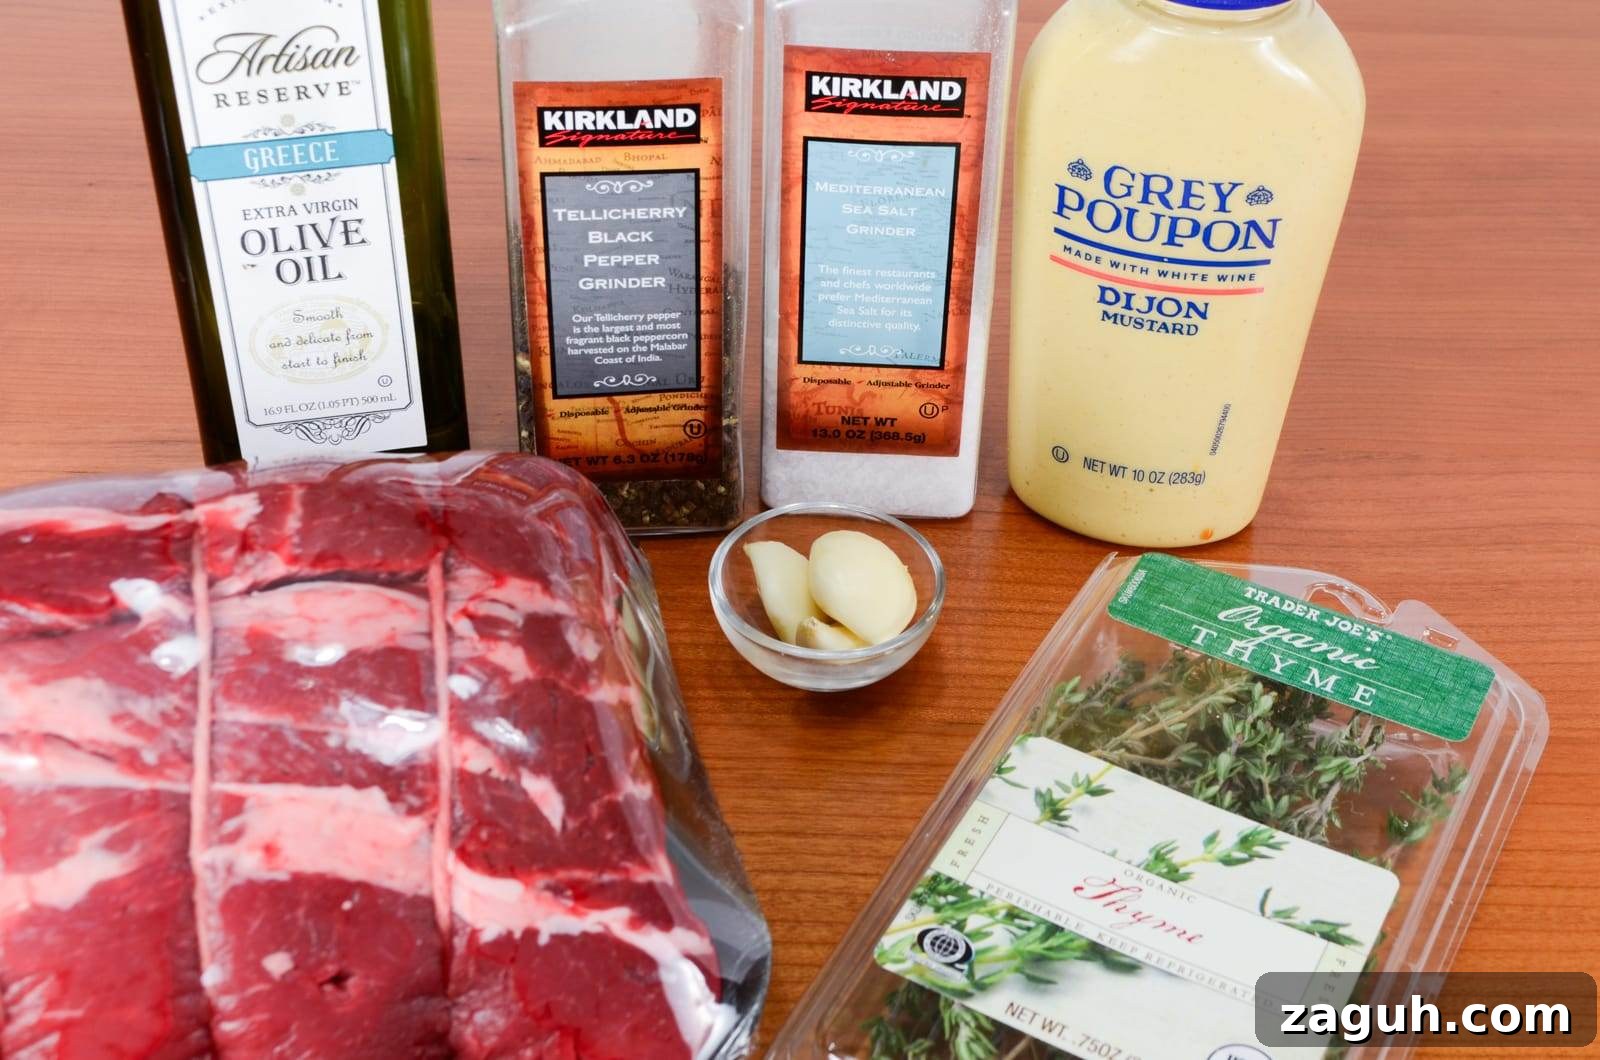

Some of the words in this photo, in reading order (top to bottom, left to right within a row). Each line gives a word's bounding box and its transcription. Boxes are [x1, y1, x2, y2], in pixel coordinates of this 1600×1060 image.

[196, 25, 360, 84] Artisan
[214, 81, 353, 109] RESERVE
[811, 75, 962, 101] KIRKLAND
[811, 96, 960, 114] Signature
[543, 108, 697, 131] KIRKLAND
[545, 129, 696, 148] Signature
[243, 140, 340, 174] GREECE
[815, 181, 945, 197] MEDITERRANEAN
[1103, 164, 1244, 213] GREY
[241, 205, 297, 221] EXTRA
[303, 198, 359, 215] VIRGIN
[552, 207, 687, 222] TELLICHERRY
[842, 203, 872, 215] SEA
[878, 204, 917, 217] SALT
[1052, 182, 1282, 253] POUPON
[240, 216, 370, 256] OLIVE
[588, 231, 653, 244] BLACK
[846, 223, 916, 237] GRINDER
[275, 254, 346, 285] OIL
[583, 254, 660, 267] PEPPER
[1063, 244, 1102, 265] MADE
[1110, 259, 1149, 276] WITH
[1157, 268, 1208, 282] WHITE
[1217, 272, 1257, 283] WINE
[818, 264, 839, 274] The
[842, 265, 872, 277] finest
[875, 267, 936, 279] restaurants
[578, 276, 666, 290] GRINDER
[820, 278, 840, 289] and
[843, 279, 872, 290] chefs
[874, 281, 932, 293] worldwide
[818, 292, 851, 304] prefer
[854, 293, 933, 305] Mediterranean
[1097, 284, 1209, 320] DIJON
[293, 307, 343, 324] Smooth
[572, 314, 592, 323] Our
[594, 312, 644, 323] Tellicherry
[647, 310, 682, 322] pepper
[837, 306, 855, 316] Sea
[858, 306, 877, 316] Salt
[880, 307, 896, 317] for
[899, 308, 912, 318] its
[573, 326, 581, 334] is
[586, 324, 600, 333] the
[602, 323, 634, 335] largest
[636, 322, 654, 332] and
[656, 321, 681, 331] most
[828, 318, 881, 330] distinctive
[885, 320, 921, 332] quality.
[1100, 309, 1199, 337] MUSTARD
[269, 338, 291, 349] and
[296, 332, 341, 347] delicate
[345, 329, 374, 345] from
[566, 336, 604, 347] fragrant
[606, 334, 631, 343] black
[633, 332, 688, 344] peppercorn
[567, 346, 614, 356] harvested
[616, 345, 630, 353] on
[632, 344, 648, 352] the
[650, 342, 688, 352] Malabar
[282, 357, 310, 370] start
[316, 356, 328, 366] to
[333, 351, 368, 368] finish
[594, 355, 622, 365] Coast
[625, 354, 636, 364] of
[637, 353, 663, 363] India.
[802, 376, 852, 387] Disposable
[866, 379, 912, 390] Adjustable
[914, 381, 951, 390] Grinder
[263, 406, 283, 416] 16.9
[284, 404, 298, 415] FL
[298, 402, 316, 412] OZ
[361, 395, 379, 405] 500
[380, 393, 397, 403] mL
[559, 407, 609, 419] Disposable
[840, 415, 870, 426] NET
[874, 417, 898, 427] WT
[811, 427, 841, 439] 13.0
[845, 429, 866, 440] OZ
[870, 430, 926, 444] (368.5g)
[586, 455, 608, 465] WT
[613, 454, 635, 464] 6.3
[640, 453, 659, 463] OZ
[1083, 456, 1106, 474] NET
[1109, 463, 1128, 479] WT
[1132, 469, 1145, 482] 10
[1148, 471, 1166, 484] OZ
[1168, 470, 1206, 486] (283g)
[1243, 586, 1320, 622] TRADER
[1325, 614, 1382, 643] JOE'S
[1217, 604, 1380, 670] Organic
[1190, 624, 1377, 707] THYME
[1122, 868, 1198, 904] ORGANIC
[1072, 876, 1205, 945] Thyme
[1004, 1001, 1039, 1025] NET
